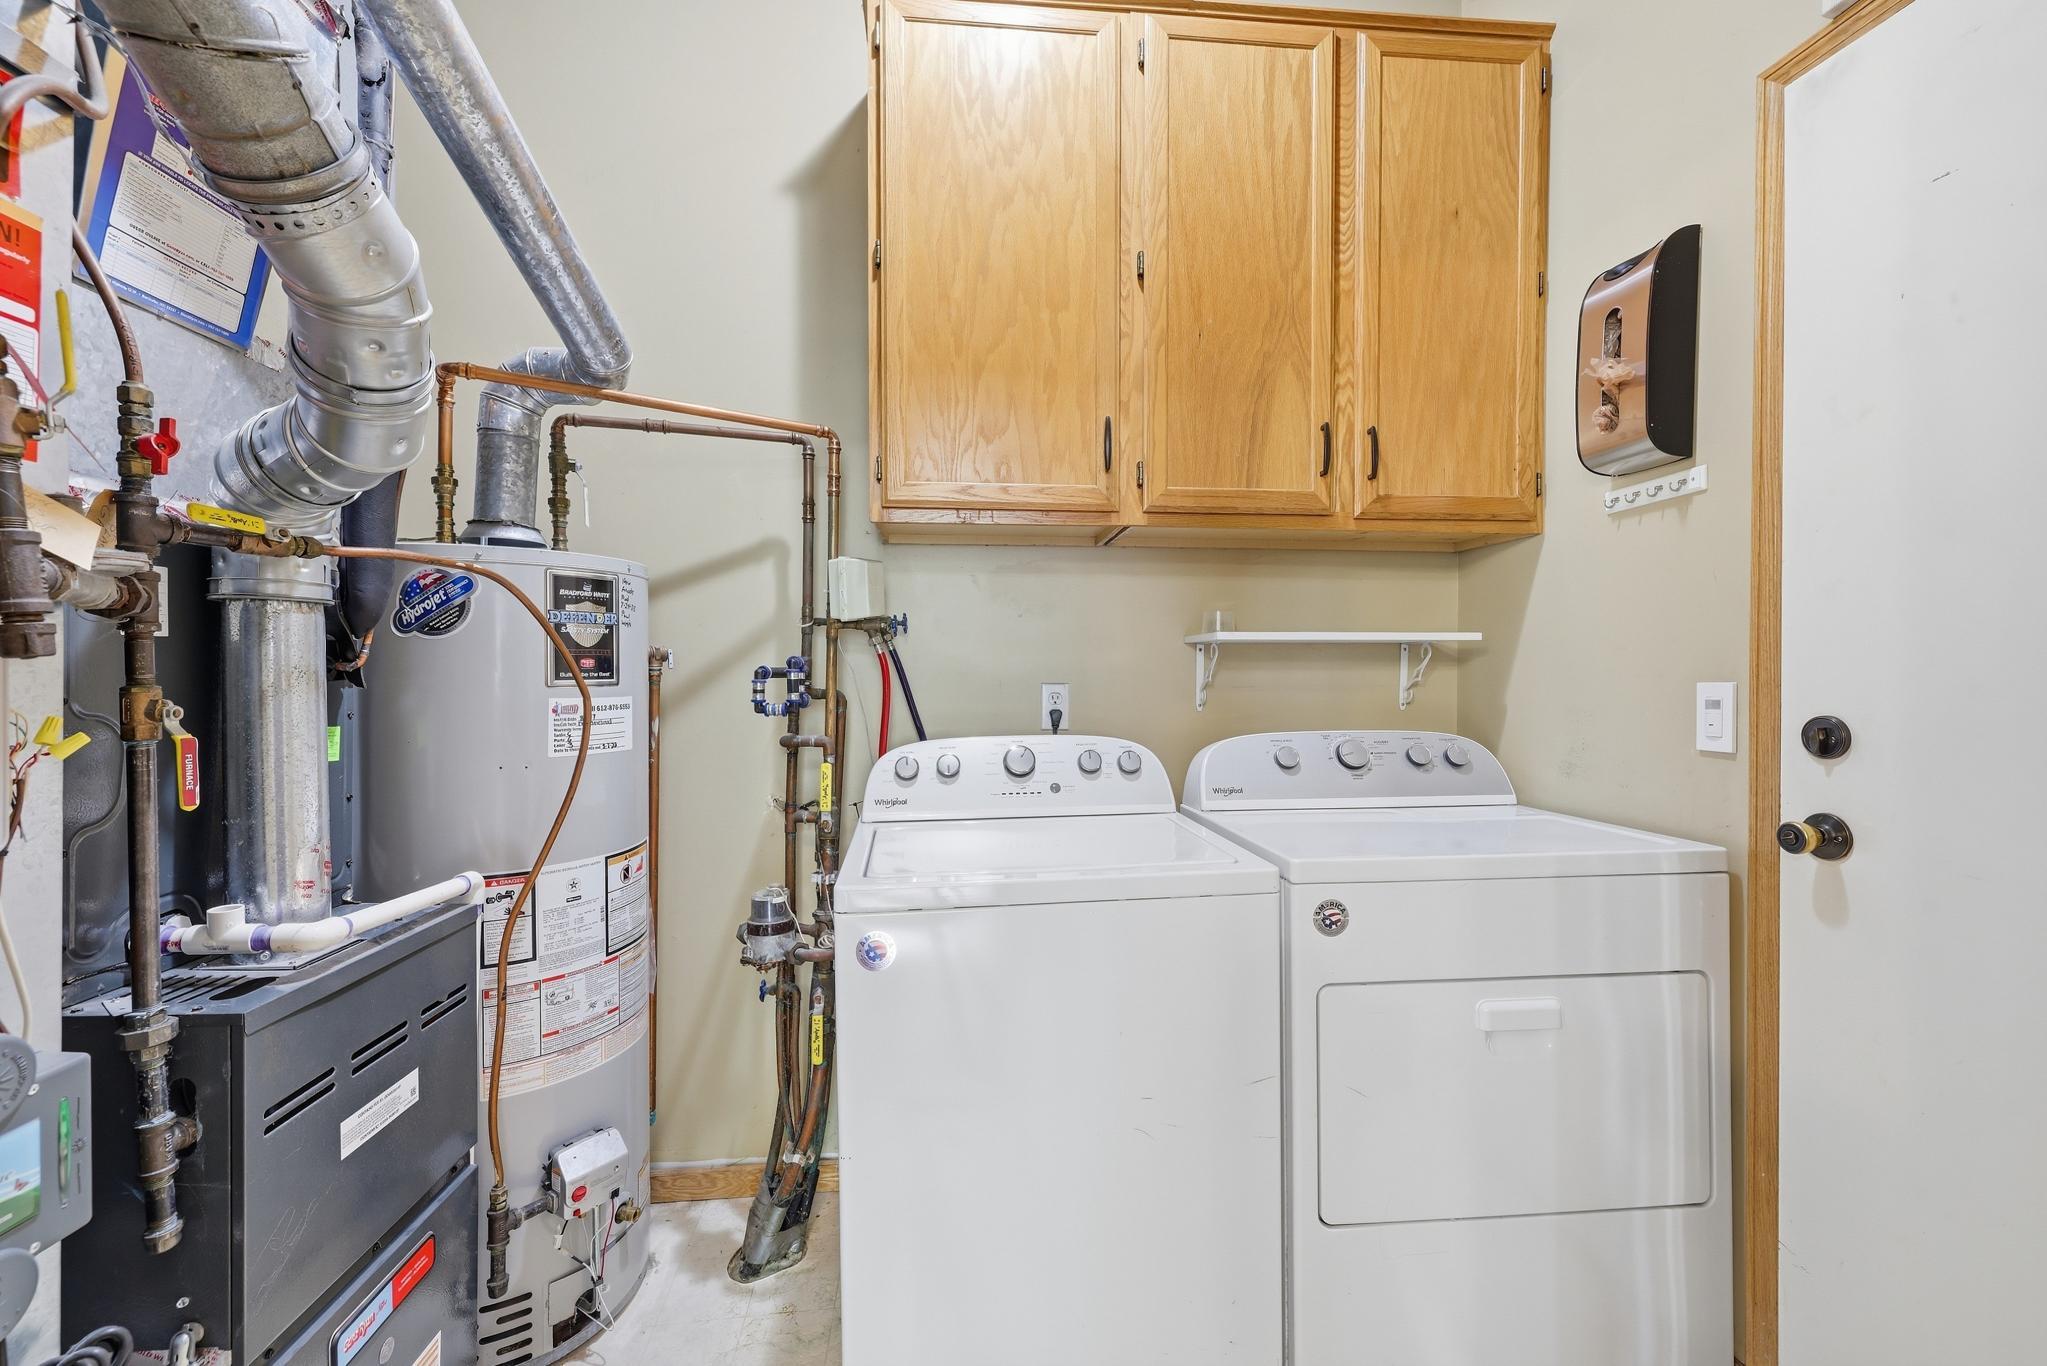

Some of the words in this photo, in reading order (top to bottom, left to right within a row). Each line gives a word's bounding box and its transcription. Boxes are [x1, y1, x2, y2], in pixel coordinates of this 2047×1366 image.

[559, 588, 593, 597] BRADFORD
[593, 591, 610, 599] WHITE
[401, 588, 447, 625] Hydrojet
[548, 609, 618, 625] DEFENDER
[184, 753, 194, 791] FURNACE
[1212, 786, 1244, 797] Whirlpool
[874, 797, 908, 808] Whirlpool
[500, 877, 526, 886] DANGER
[1315, 901, 1346, 917] AMERICA
